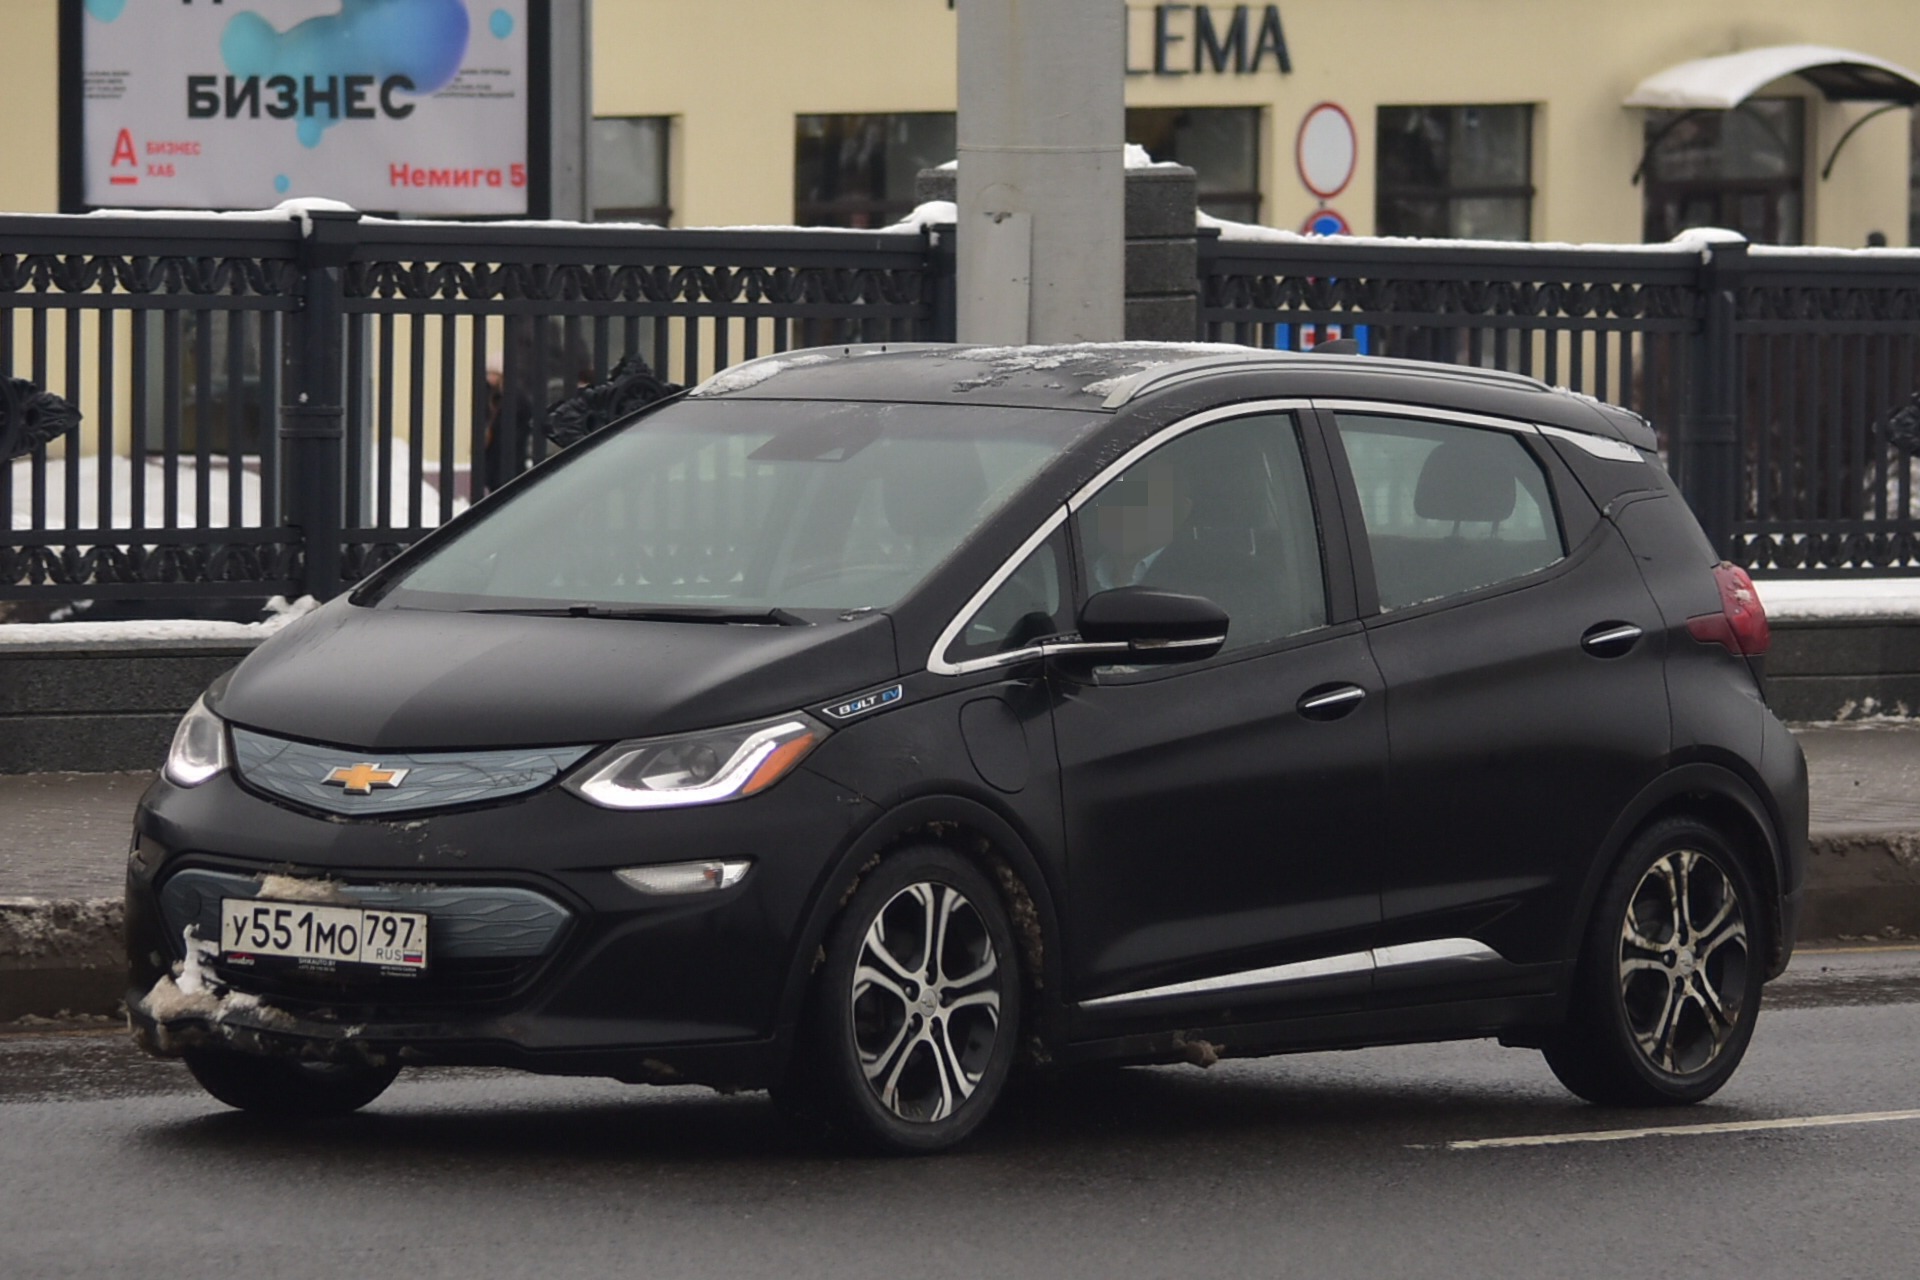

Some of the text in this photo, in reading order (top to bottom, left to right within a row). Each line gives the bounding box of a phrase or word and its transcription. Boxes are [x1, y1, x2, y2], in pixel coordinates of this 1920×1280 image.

[187, 74, 416, 120] БИЗНЕС
[146, 141, 202, 156] БИЗНЕС
[147, 163, 176, 177] ХАБ
[390, 162, 527, 188] Немига 5
[838, 688, 899, 715] BOLT EV
[365, 914, 416, 949] 797
[375, 947, 402, 961] RUS
